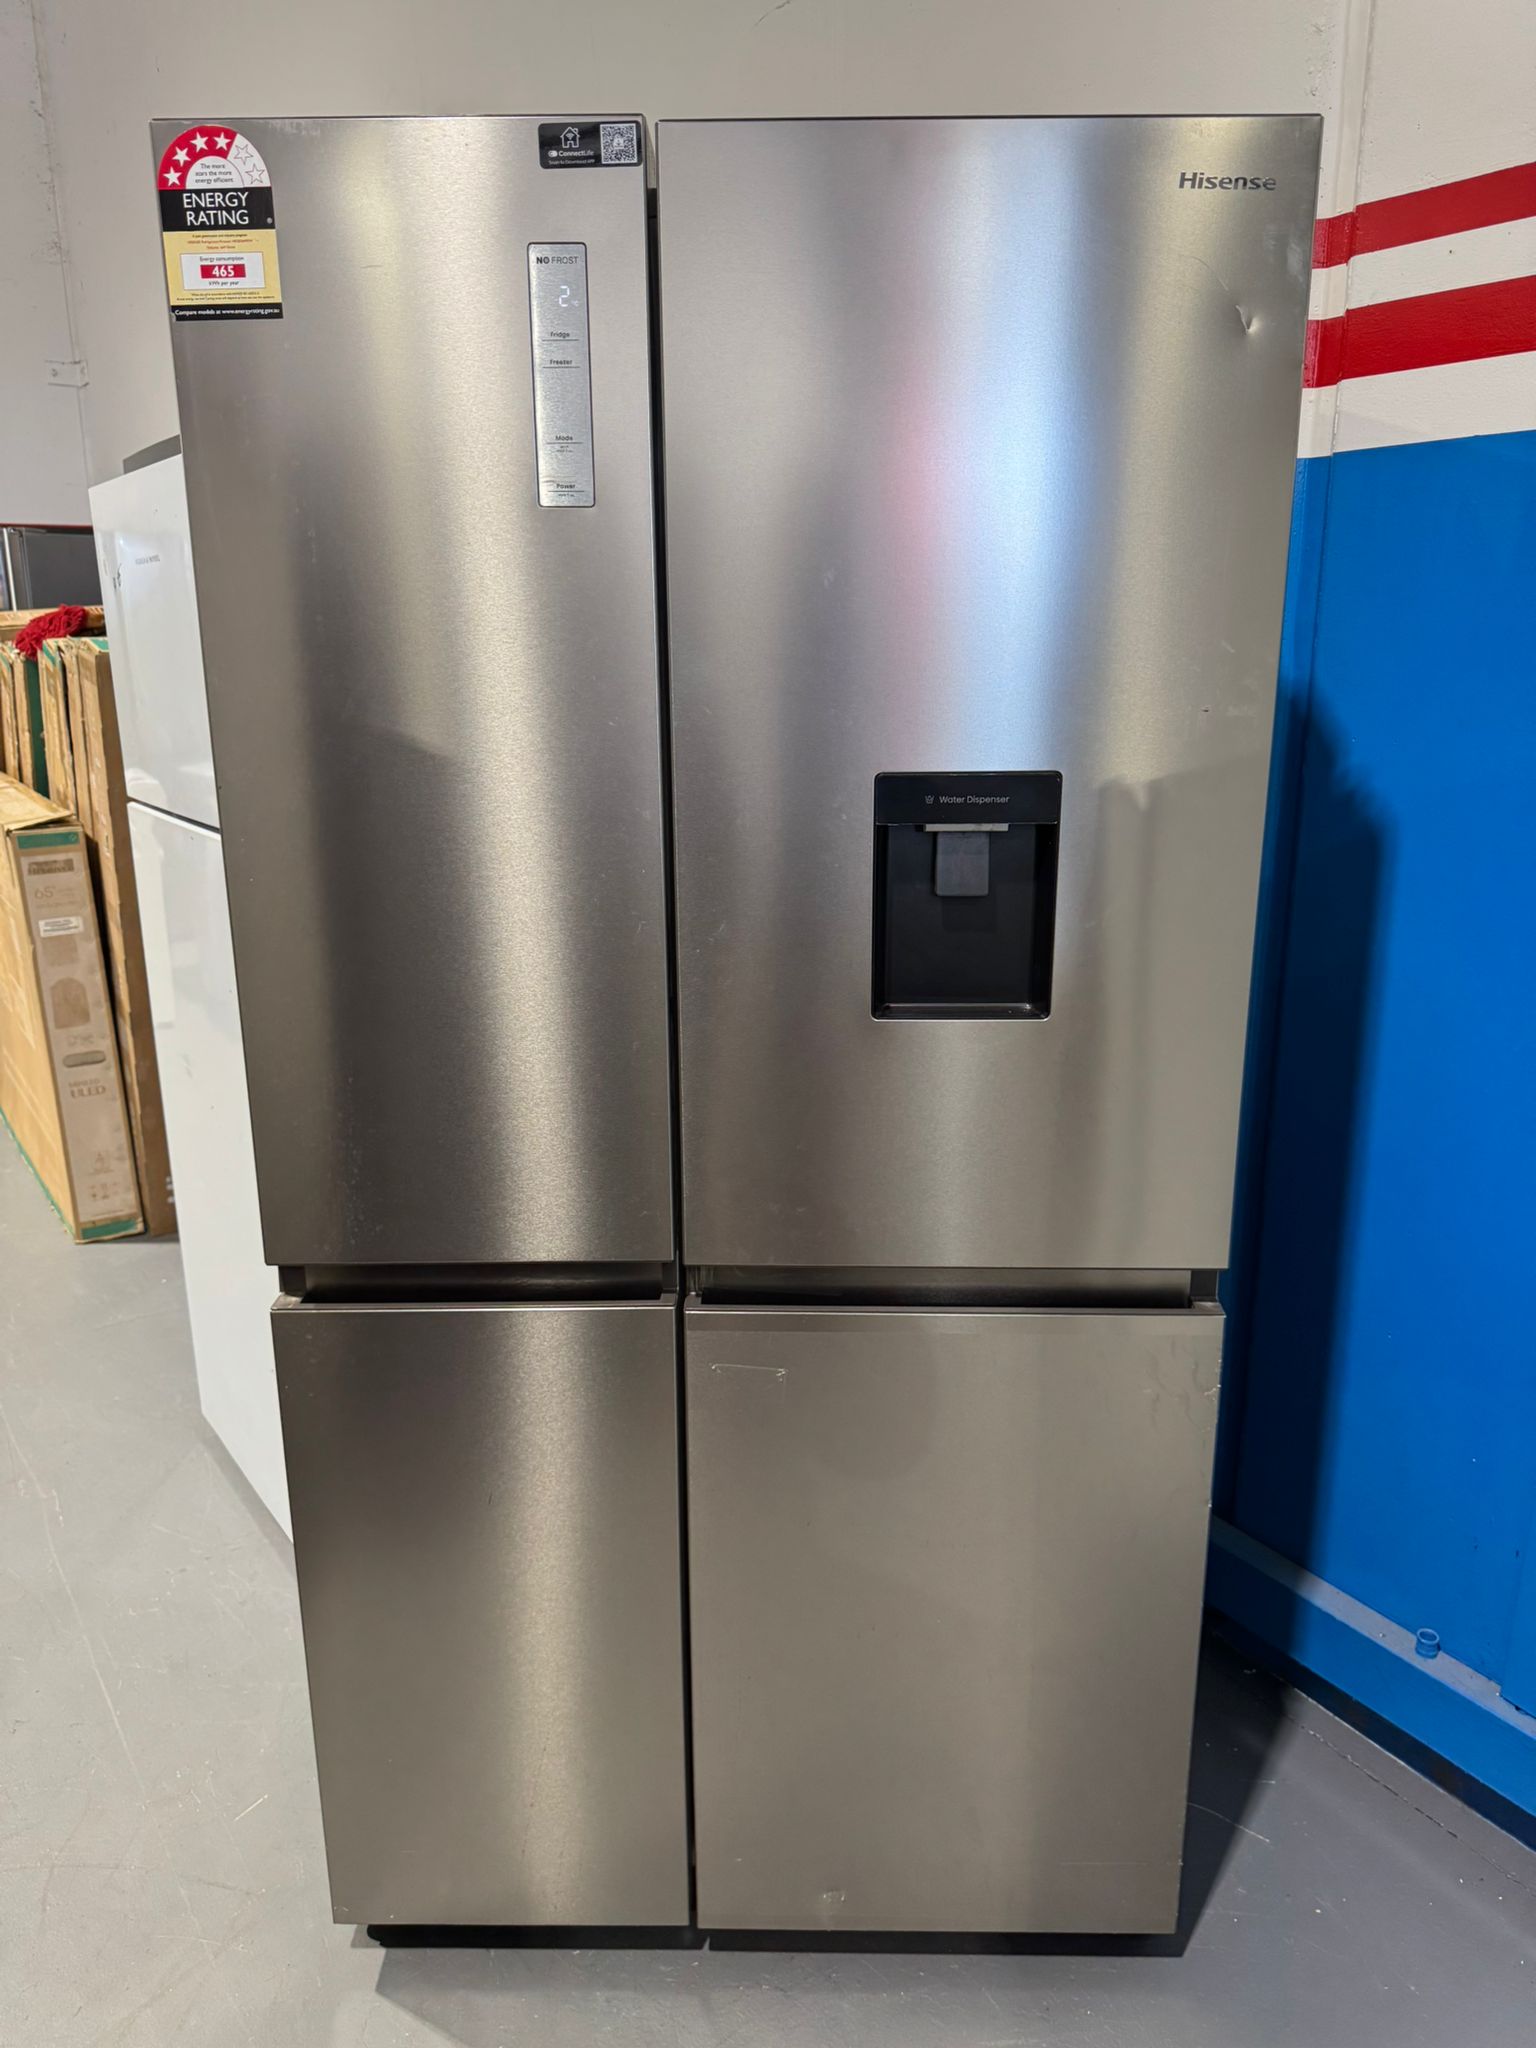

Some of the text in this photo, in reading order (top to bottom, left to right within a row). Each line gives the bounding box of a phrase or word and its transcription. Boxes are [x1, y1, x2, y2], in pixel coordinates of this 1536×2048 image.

[558, 149, 595, 157] ConnectLife
[1178, 172, 1276, 191] Hisense
[183, 192, 249, 208] ENERGY
[186, 209, 249, 226] RATING
[536, 256, 579, 264] NO FROST
[212, 265, 235, 277] 465
[558, 285, 571, 307] 2
[174, 309, 197, 317] Compare
[550, 331, 570, 339] Fridge
[939, 795, 1010, 805] Water Dispenser
[70, 1086, 106, 1098] ULED
